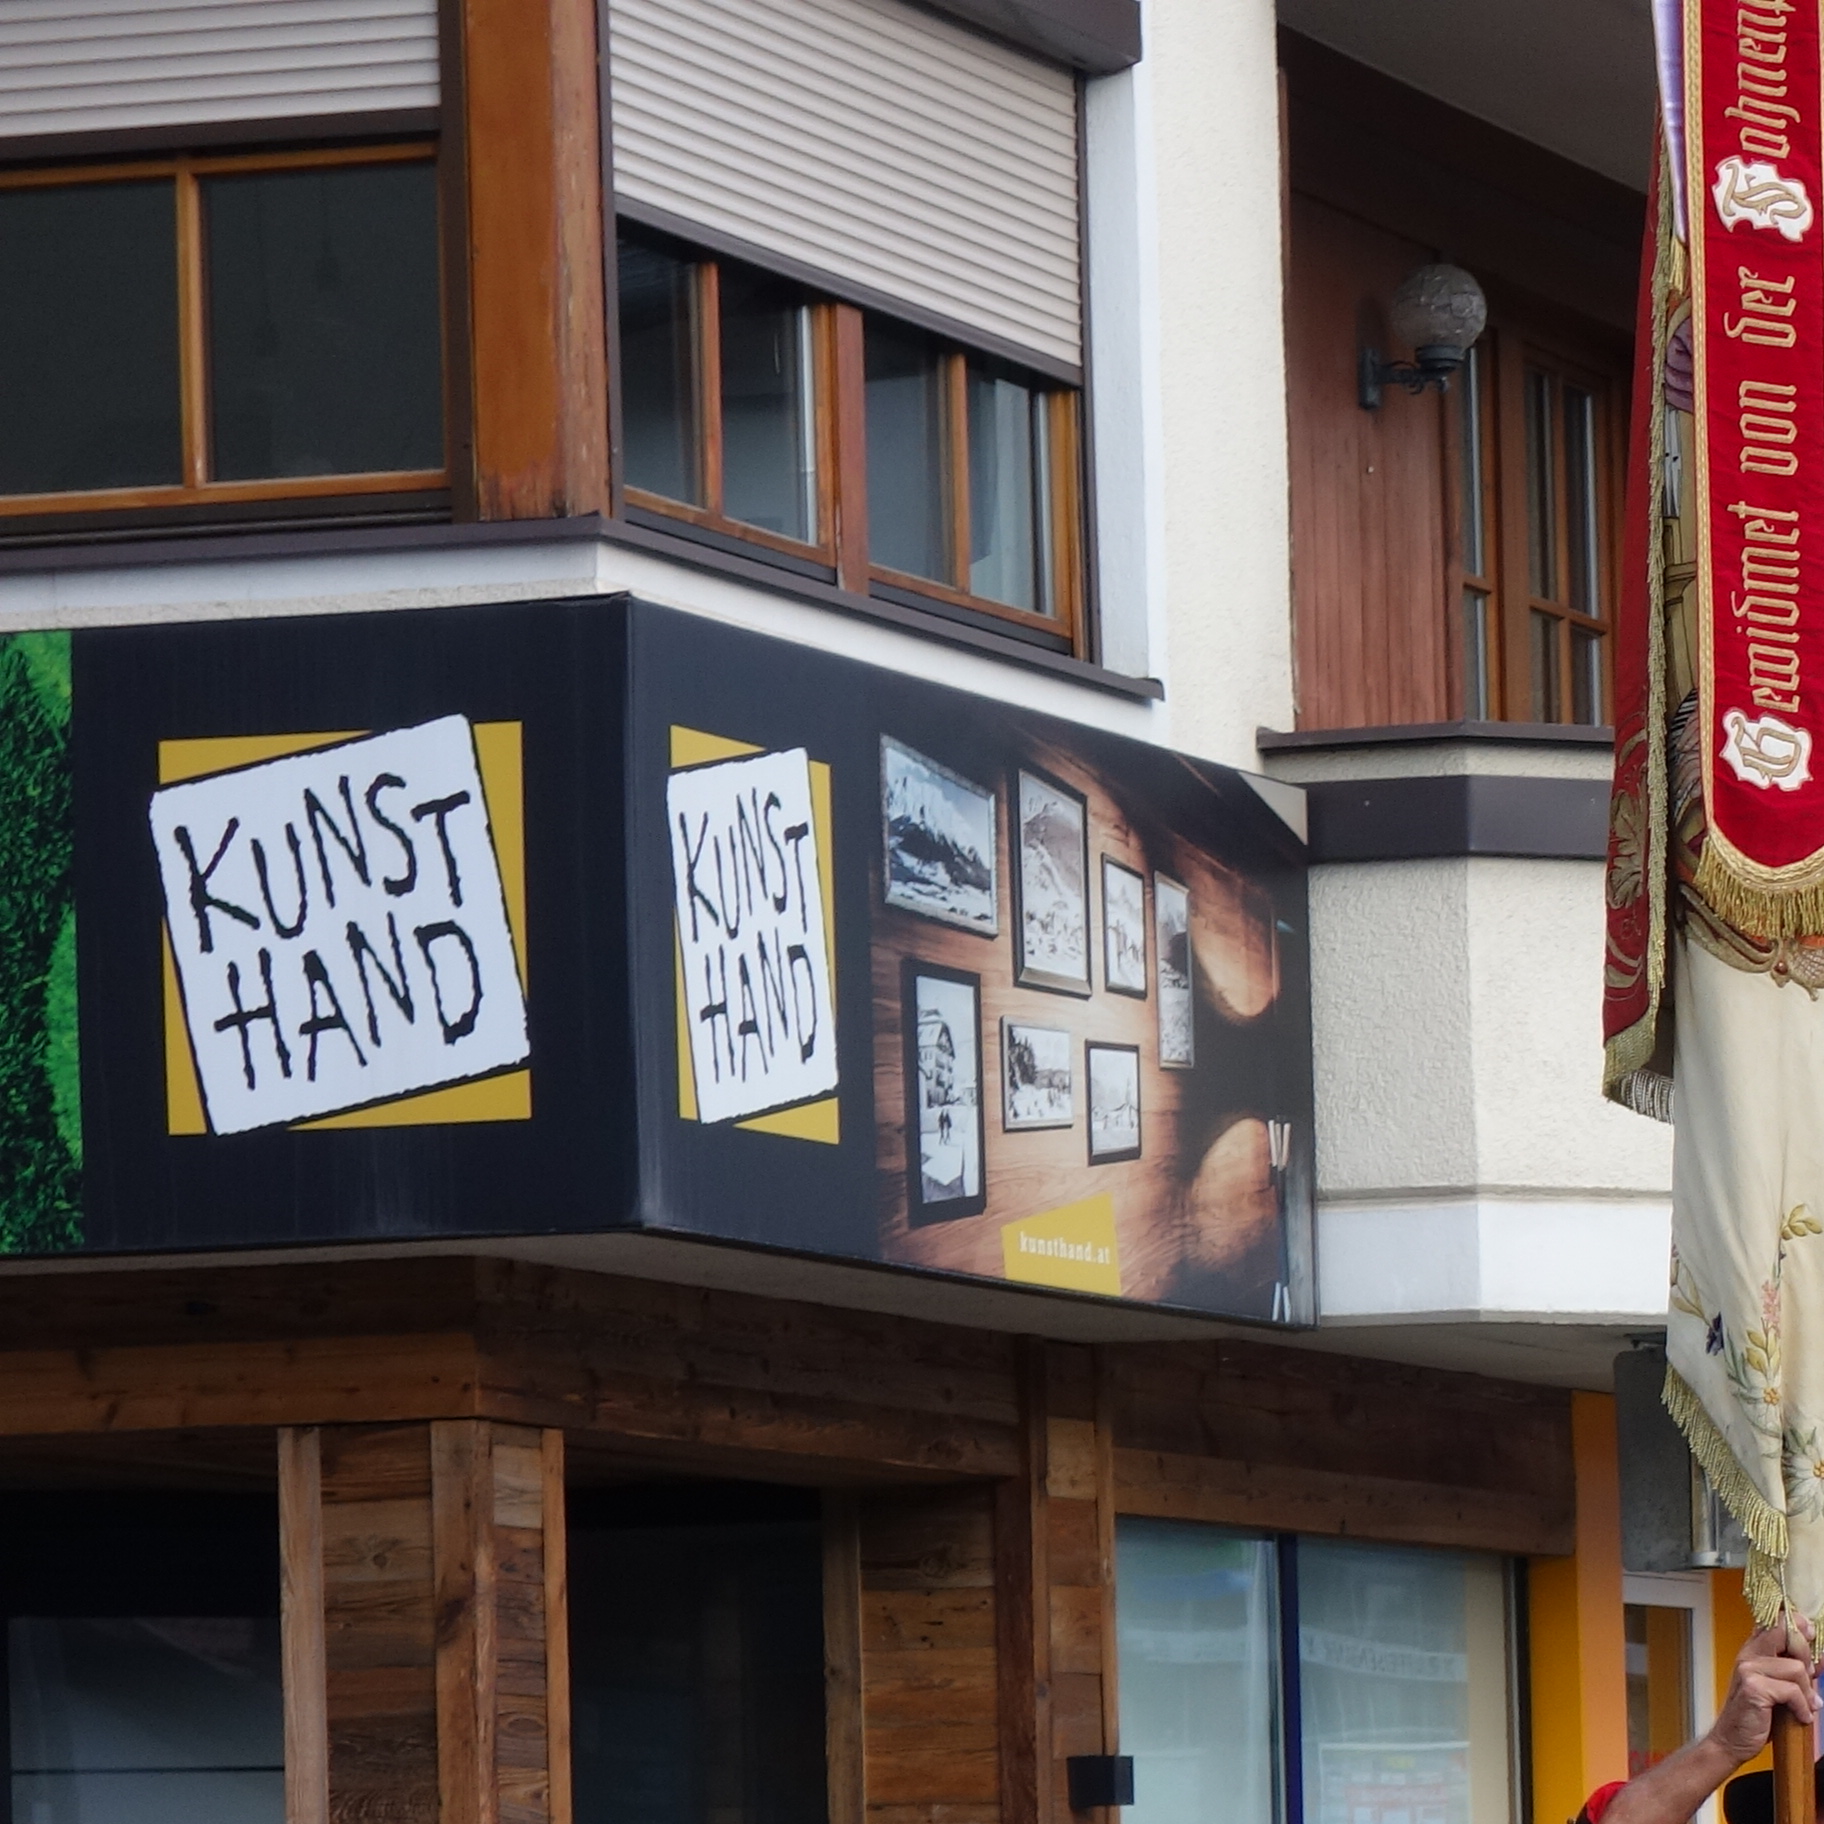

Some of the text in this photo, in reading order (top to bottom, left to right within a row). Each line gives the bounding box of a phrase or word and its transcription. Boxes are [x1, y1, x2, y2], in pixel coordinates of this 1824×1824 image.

[1723, 266, 1797, 348] der
[1738, 380, 1799, 477] von
[1727, 500, 1801, 783] Gewidmet
[174, 772, 471, 954] KUNST
[679, 786, 808, 943] KUNST
[214, 911, 483, 1091] HAND
[700, 927, 817, 1084] HAND
[1019, 1231, 1110, 1265] kunsthand.at
